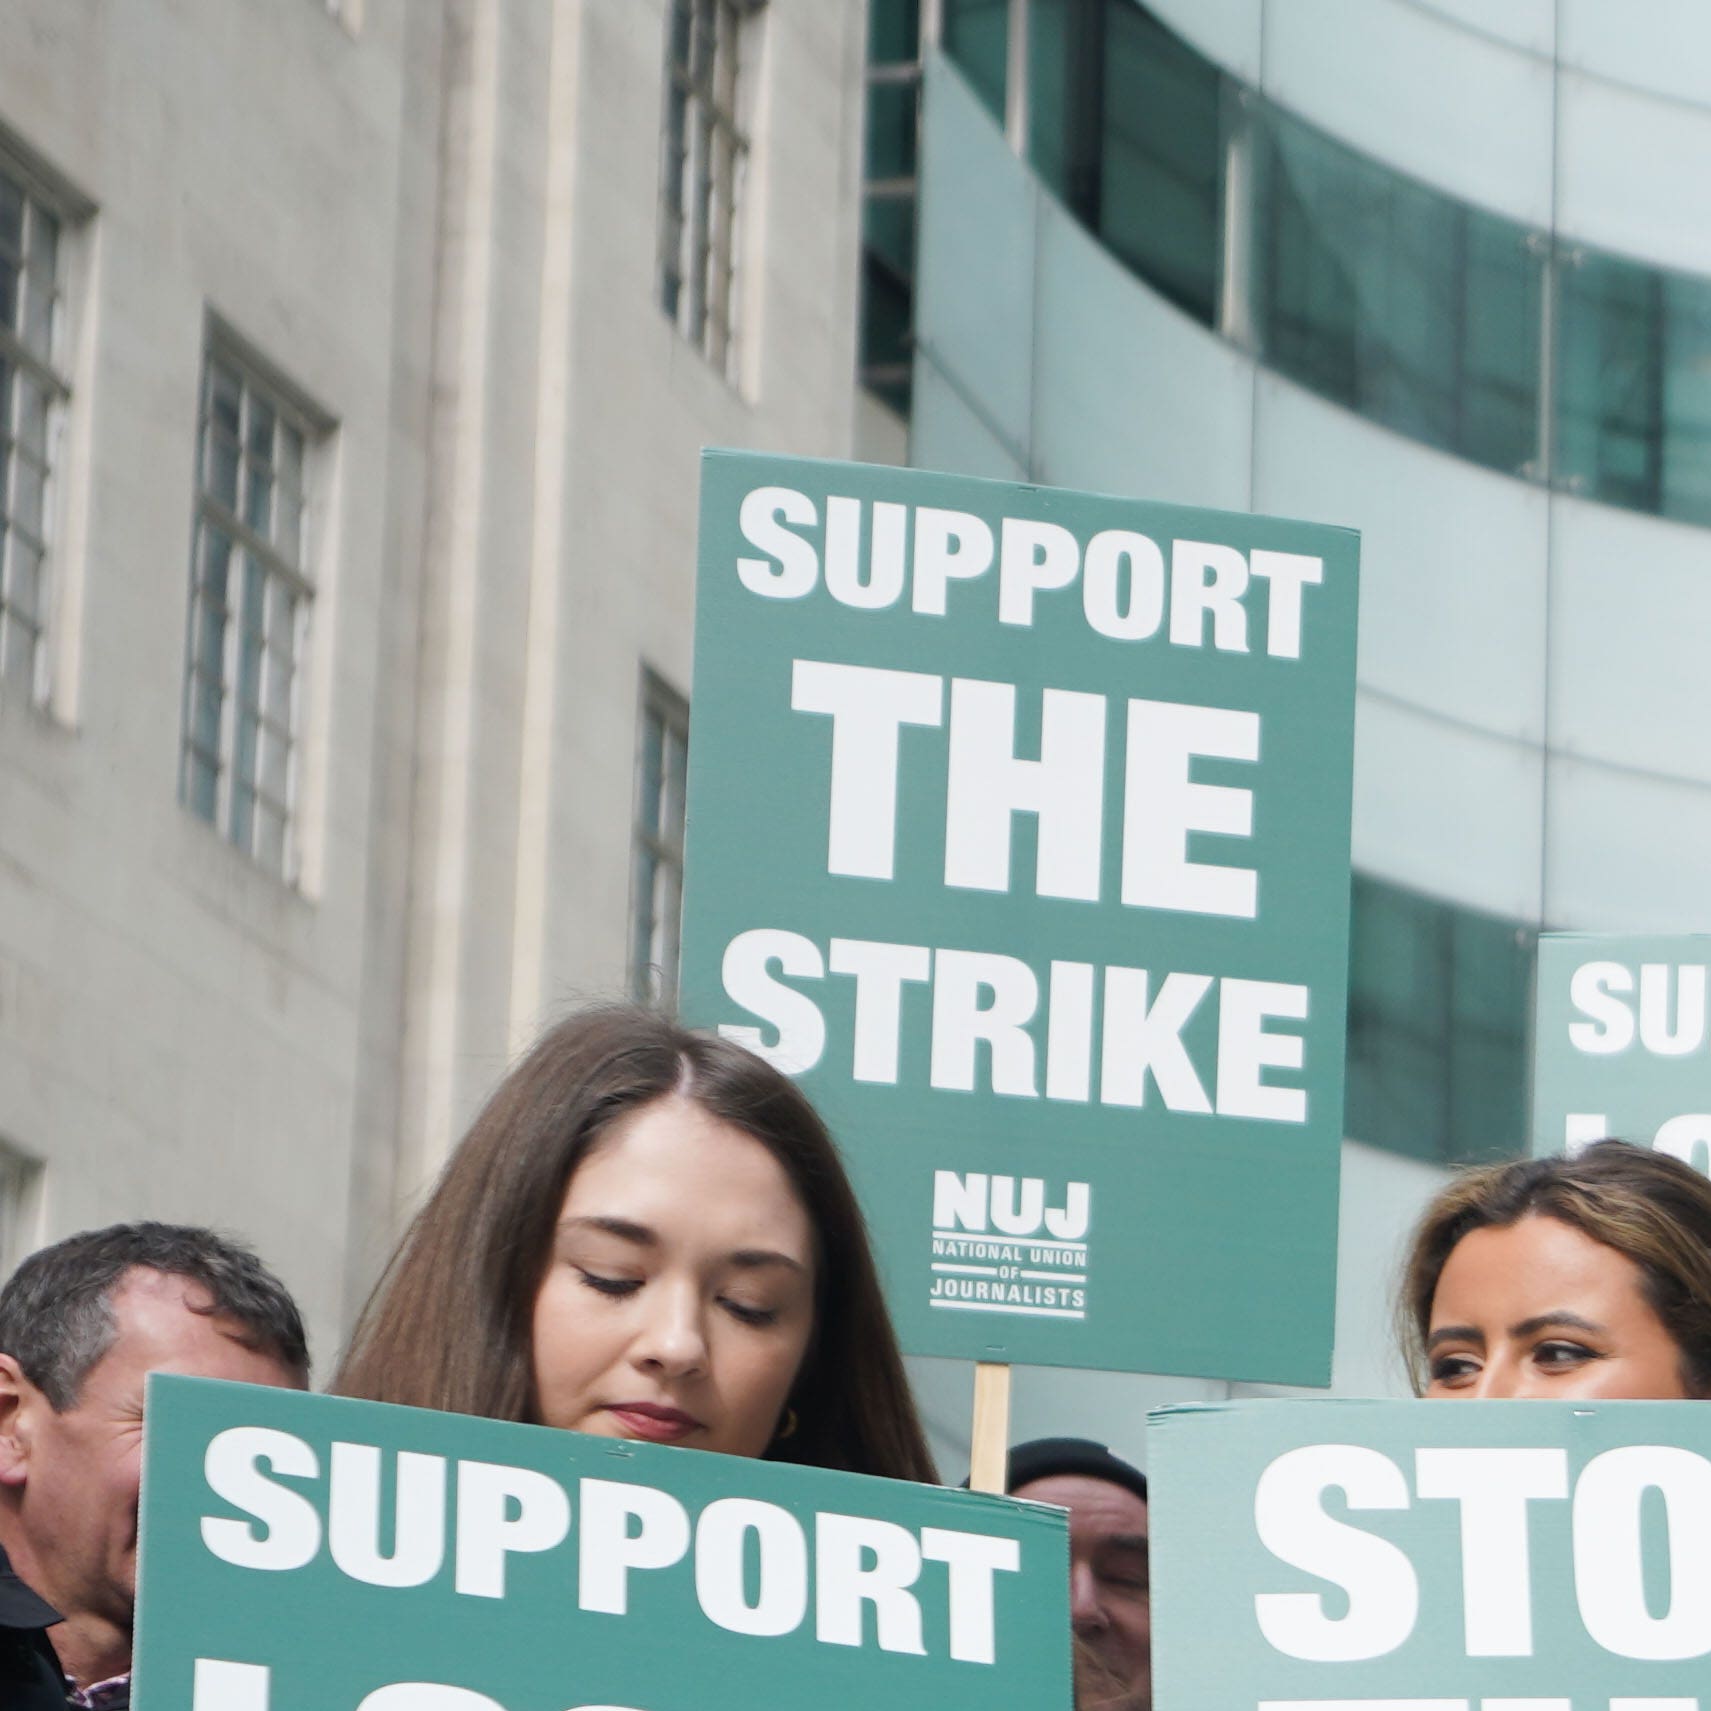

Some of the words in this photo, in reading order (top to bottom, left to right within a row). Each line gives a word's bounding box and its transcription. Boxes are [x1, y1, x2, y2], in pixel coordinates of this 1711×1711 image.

[737, 487, 1323, 660] SUPPORT
[790, 659, 1260, 919] THE
[717, 929, 1308, 1124] STRIKE
[932, 1240, 1023, 1261] NATIONAL
[1030, 1249, 1086, 1266] UNION
[933, 1170, 1089, 1239] NUJ
[930, 1278, 1085, 1307] JOURNALISTS
[999, 1266, 1020, 1280] OF
[200, 1426, 1019, 1665] SUPPORT
